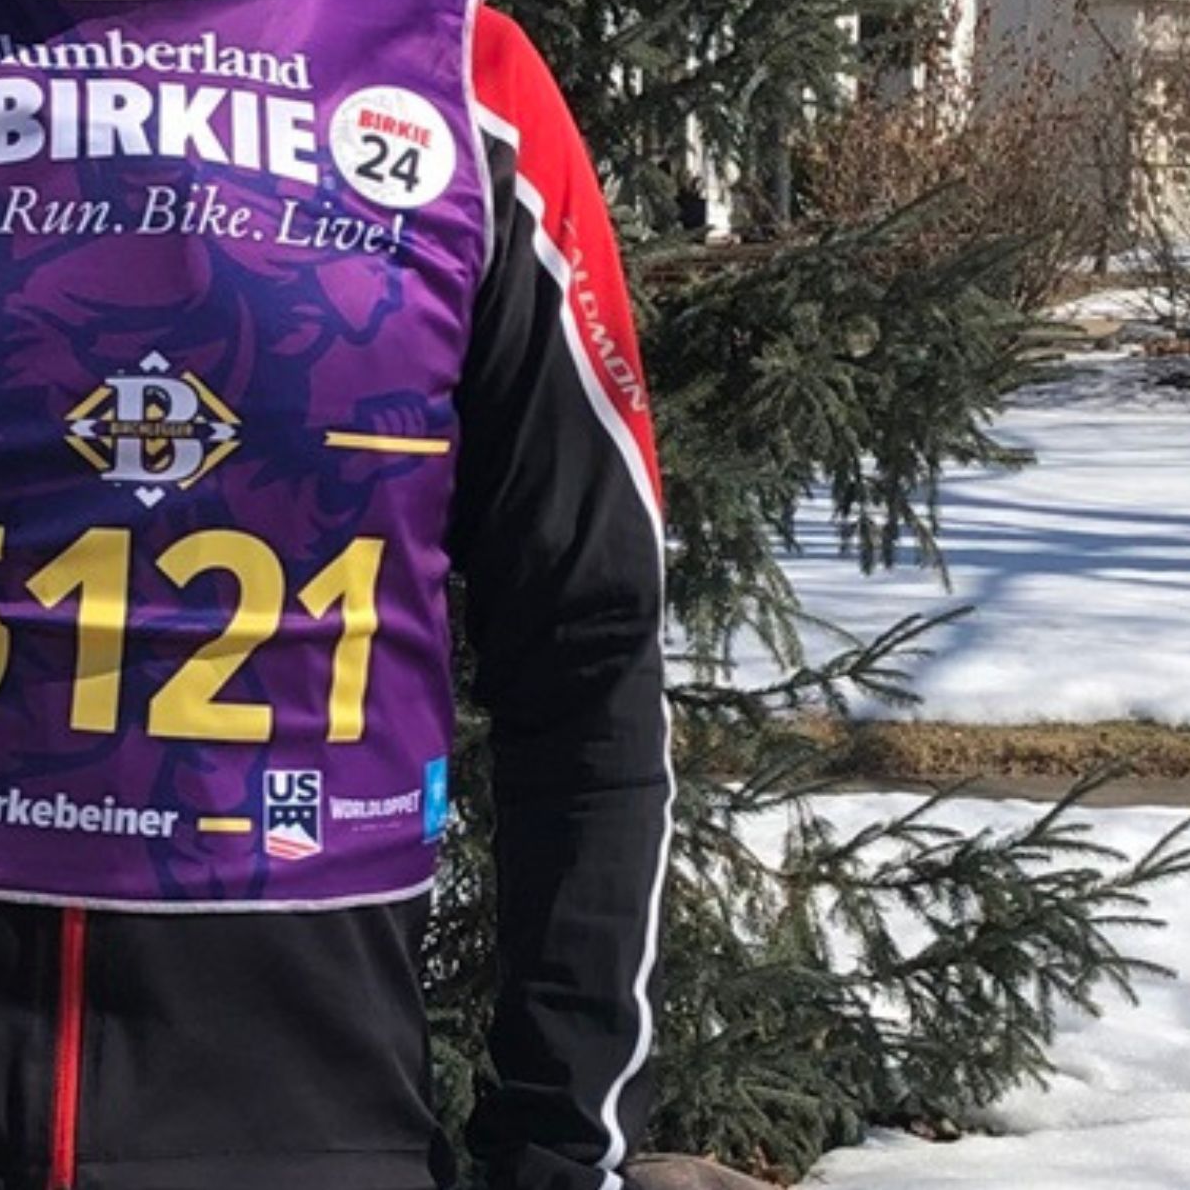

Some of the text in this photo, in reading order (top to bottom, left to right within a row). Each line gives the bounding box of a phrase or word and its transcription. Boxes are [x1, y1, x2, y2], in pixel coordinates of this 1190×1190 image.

[358, 109, 432, 149] BIRKIE
[355, 133, 421, 193] 24
[137, 183, 264, 242] Bike.
[275, 200, 405, 255] Live!
[268, 773, 318, 802] US
